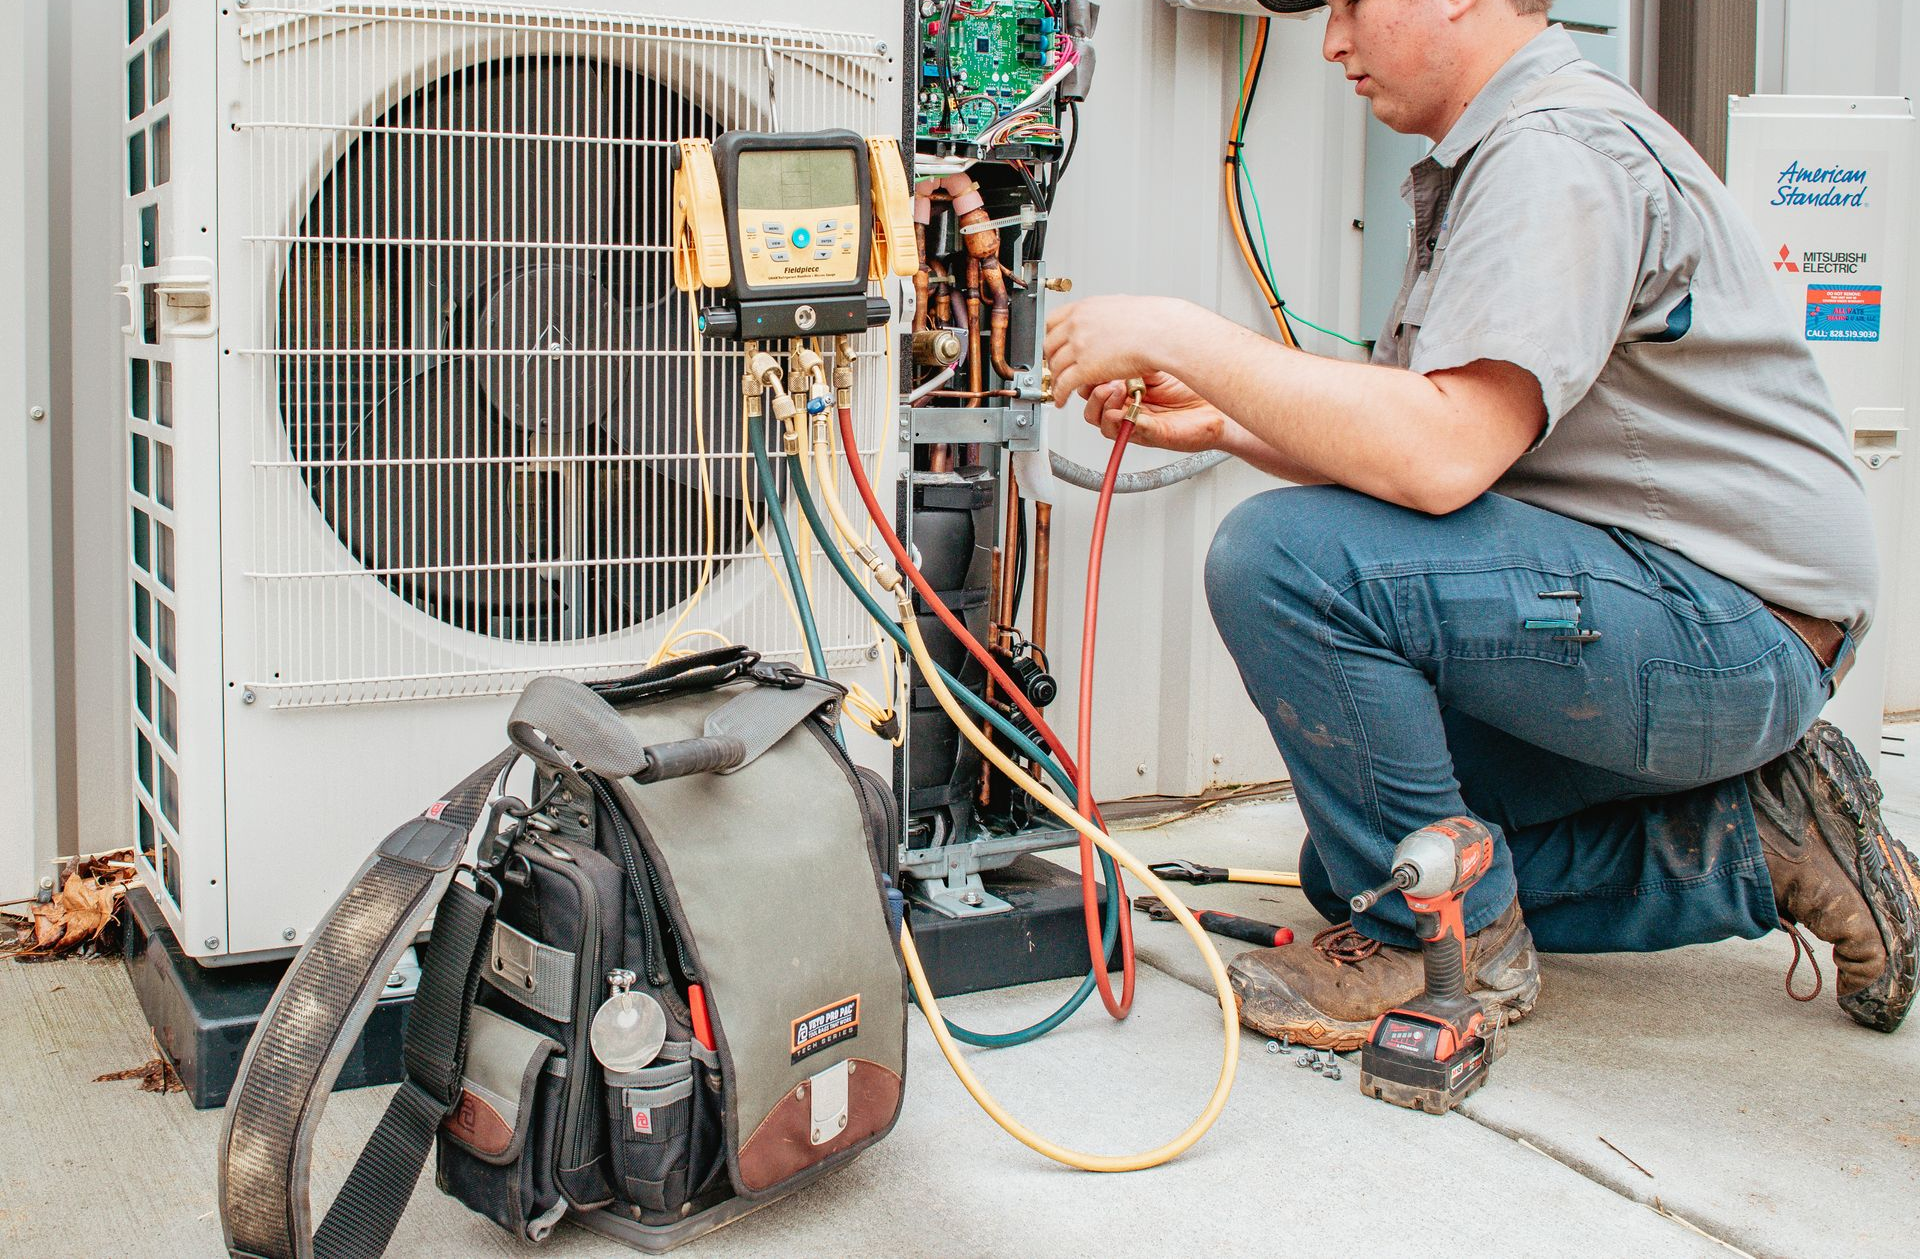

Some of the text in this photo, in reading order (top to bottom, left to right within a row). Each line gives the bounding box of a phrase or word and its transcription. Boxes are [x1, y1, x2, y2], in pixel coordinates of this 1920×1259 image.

[1777, 160, 1867, 184] American
[1770, 185, 1868, 207] Standard
[1803, 252, 1867, 263] MITSUBISHI
[784, 266, 820, 274] Fieldpiece
[1803, 263, 1858, 273] ELECTRIC
[1829, 330, 1877, 338] 828.519.9030
[826, 1009, 838, 1023] PRO
[797, 1042, 818, 1056] TECH
[821, 1027, 854, 1045] SERIES
